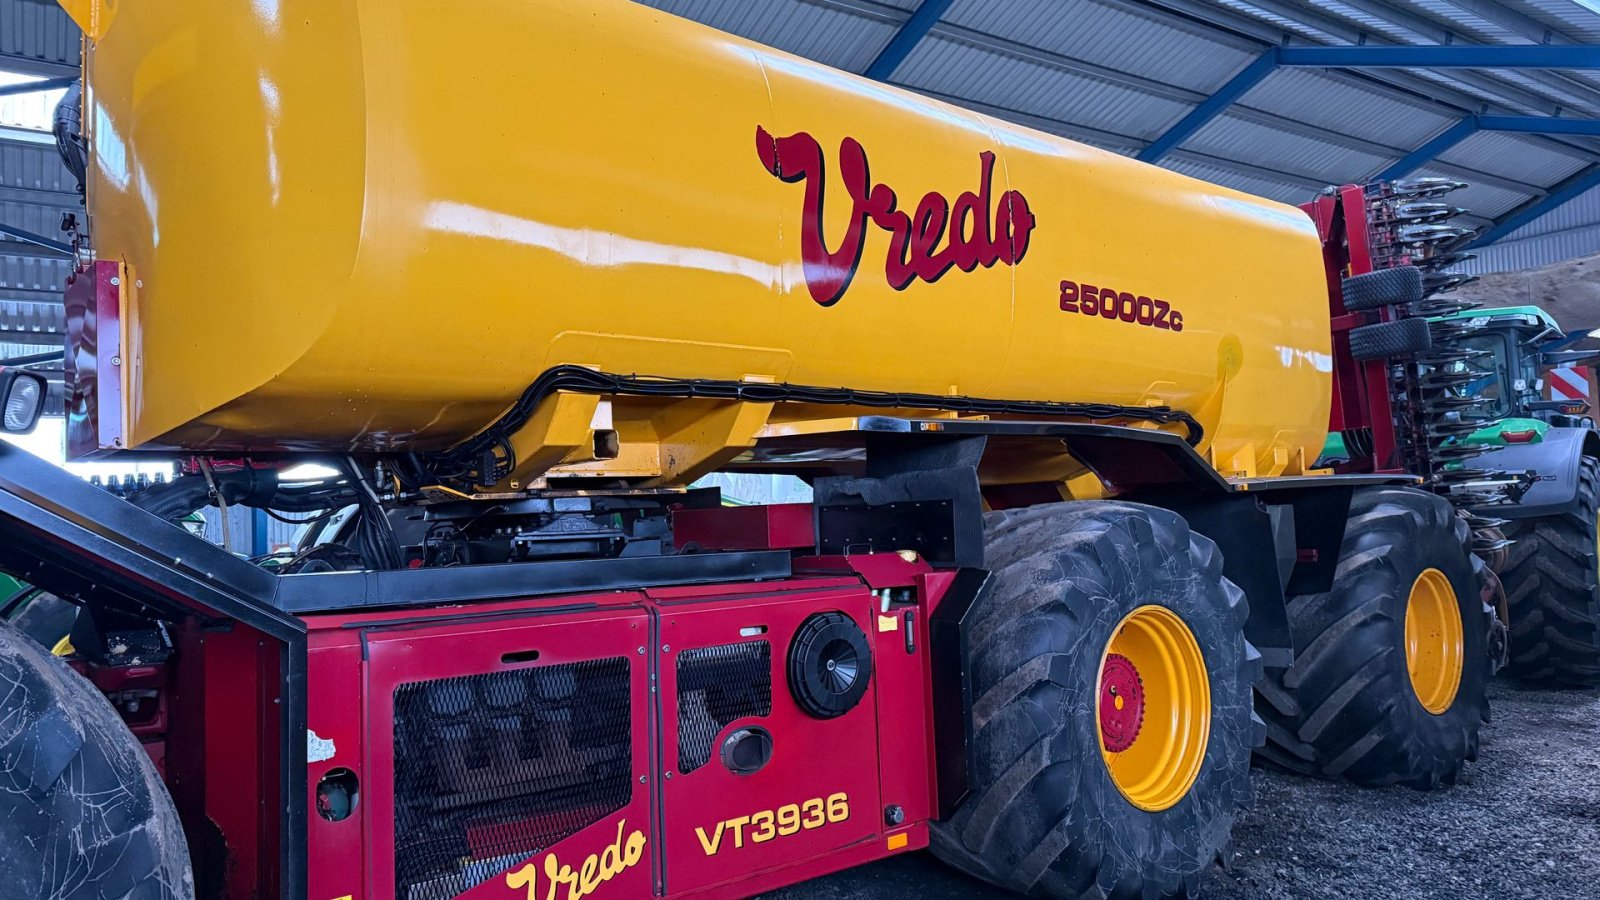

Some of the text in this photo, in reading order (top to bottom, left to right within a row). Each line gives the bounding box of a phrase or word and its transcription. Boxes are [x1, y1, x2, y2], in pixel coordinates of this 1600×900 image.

[756, 124, 1036, 307] Vredo
[505, 817, 647, 900] Vredo
[694, 791, 850, 857] VT3936
